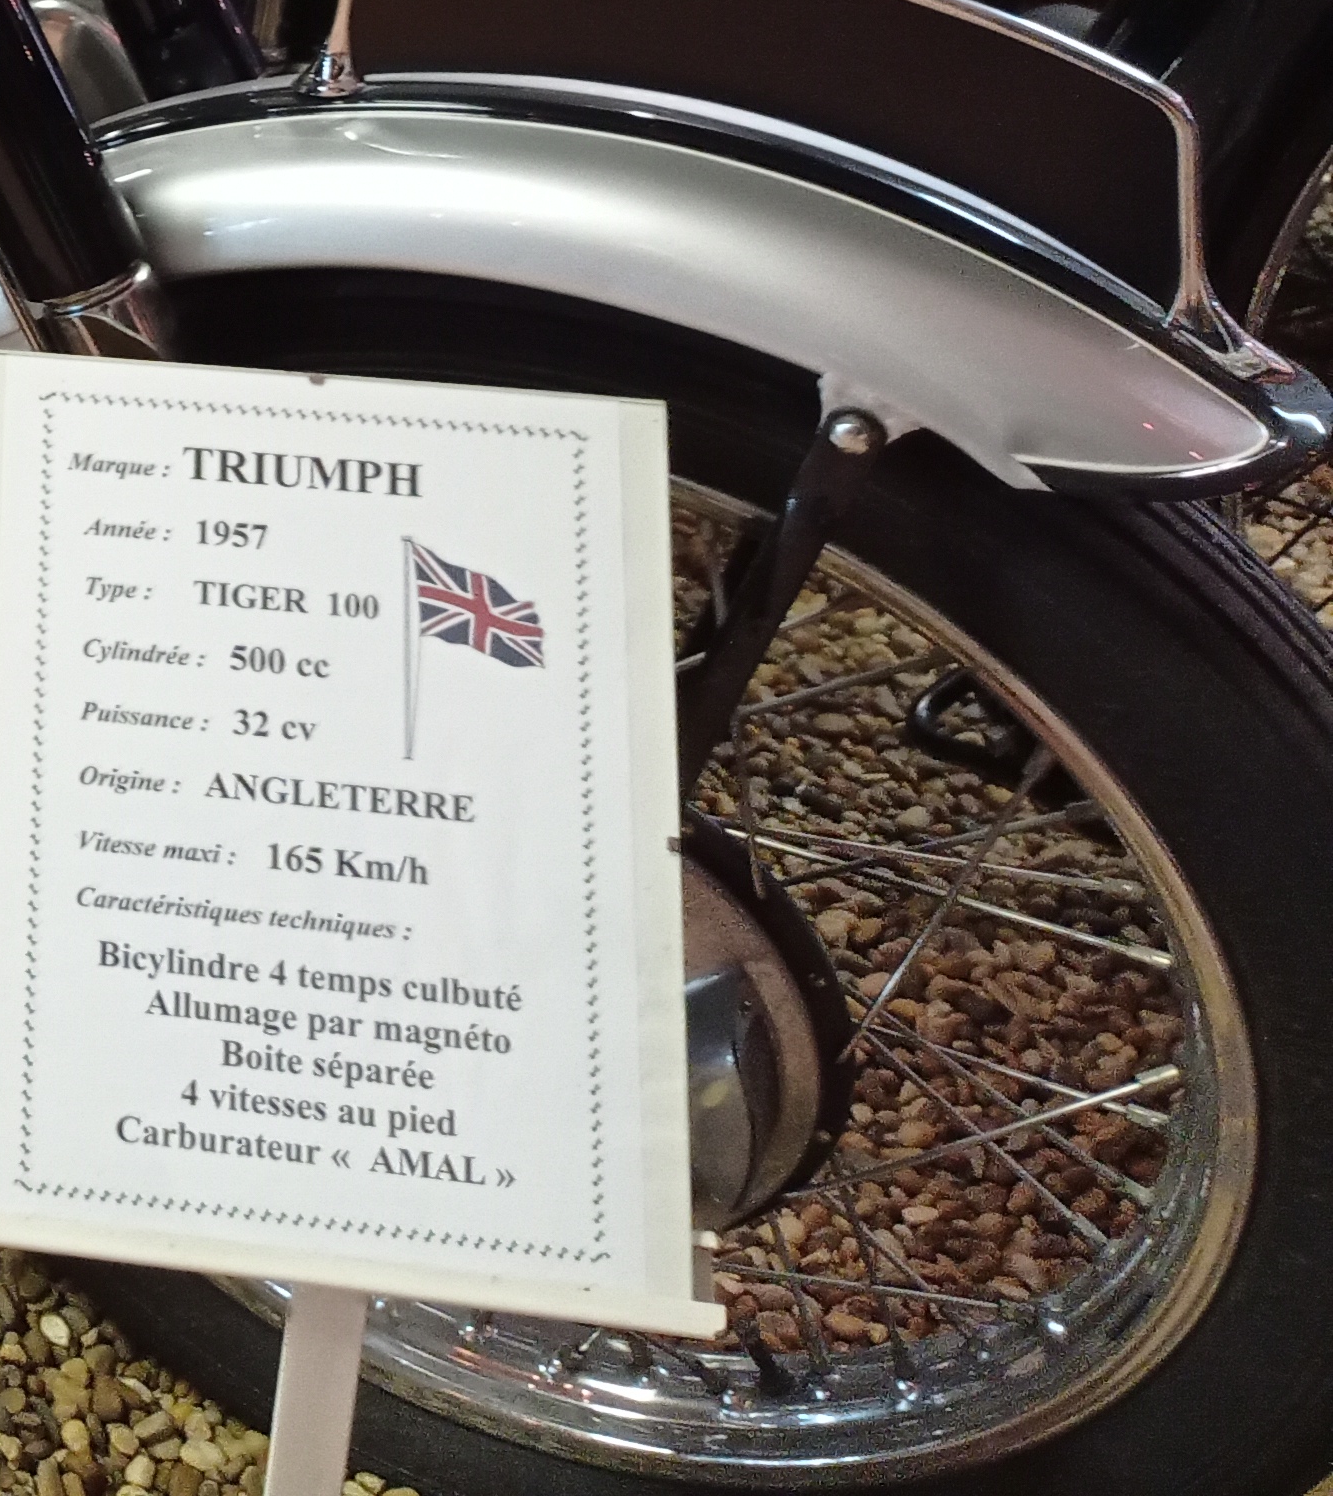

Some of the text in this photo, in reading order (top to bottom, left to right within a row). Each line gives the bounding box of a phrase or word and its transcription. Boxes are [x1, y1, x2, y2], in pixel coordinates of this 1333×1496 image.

[183, 446, 422, 498] TRIUMPH
[198, 520, 268, 550] 1957
[193, 580, 309, 614] TIGER
[329, 592, 380, 620] 100
[229, 644, 286, 674] 500
[296, 658, 329, 679] cc
[232, 708, 269, 738] 32
[281, 720, 316, 741] cv
[205, 772, 475, 823] ANGLETERRE
[80, 830, 157, 857] Vitesse
[268, 843, 323, 874] 165
[335, 849, 429, 885] Km/h
[76, 886, 263, 927] Caractéristiques
[98, 940, 522, 1012] Bicylindre 4 temps culbuté
[145, 990, 512, 1055] Allumage par magnéto
[221, 1039, 434, 1090] Boite séparée
[181, 1079, 458, 1139] 4 vitesses au pied
[116, 1115, 321, 1165] Carburateur
[369, 1147, 486, 1186] AMAL
